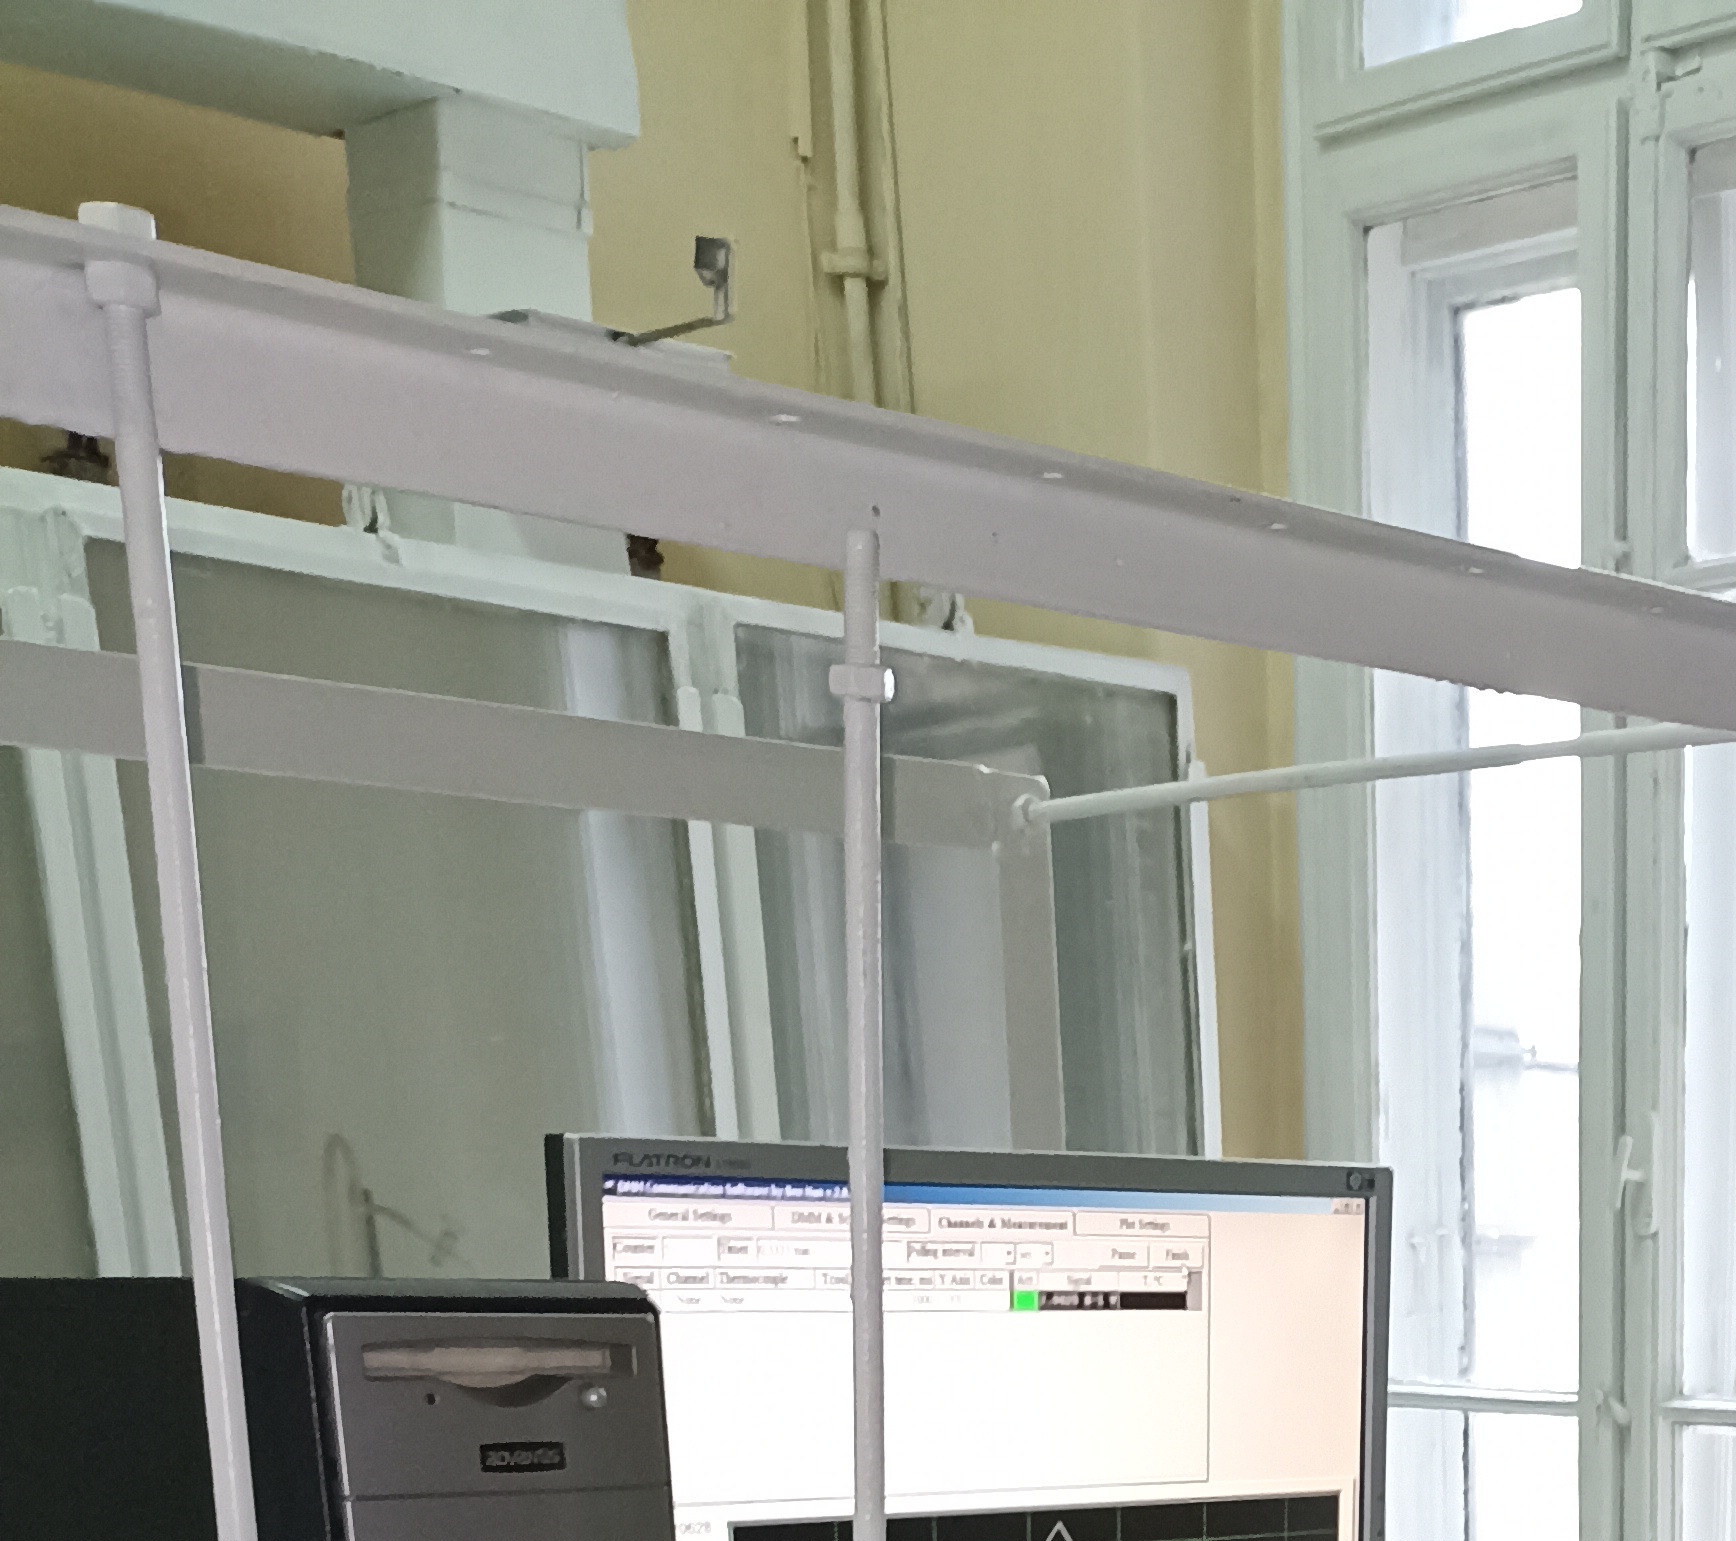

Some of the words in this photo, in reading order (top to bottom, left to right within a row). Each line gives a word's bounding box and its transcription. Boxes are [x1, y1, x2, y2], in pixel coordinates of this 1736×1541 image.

[613, 1152, 711, 1168] FLATRON
[938, 1216, 984, 1230] Channels
[1001, 1217, 1069, 1231] Measurement
